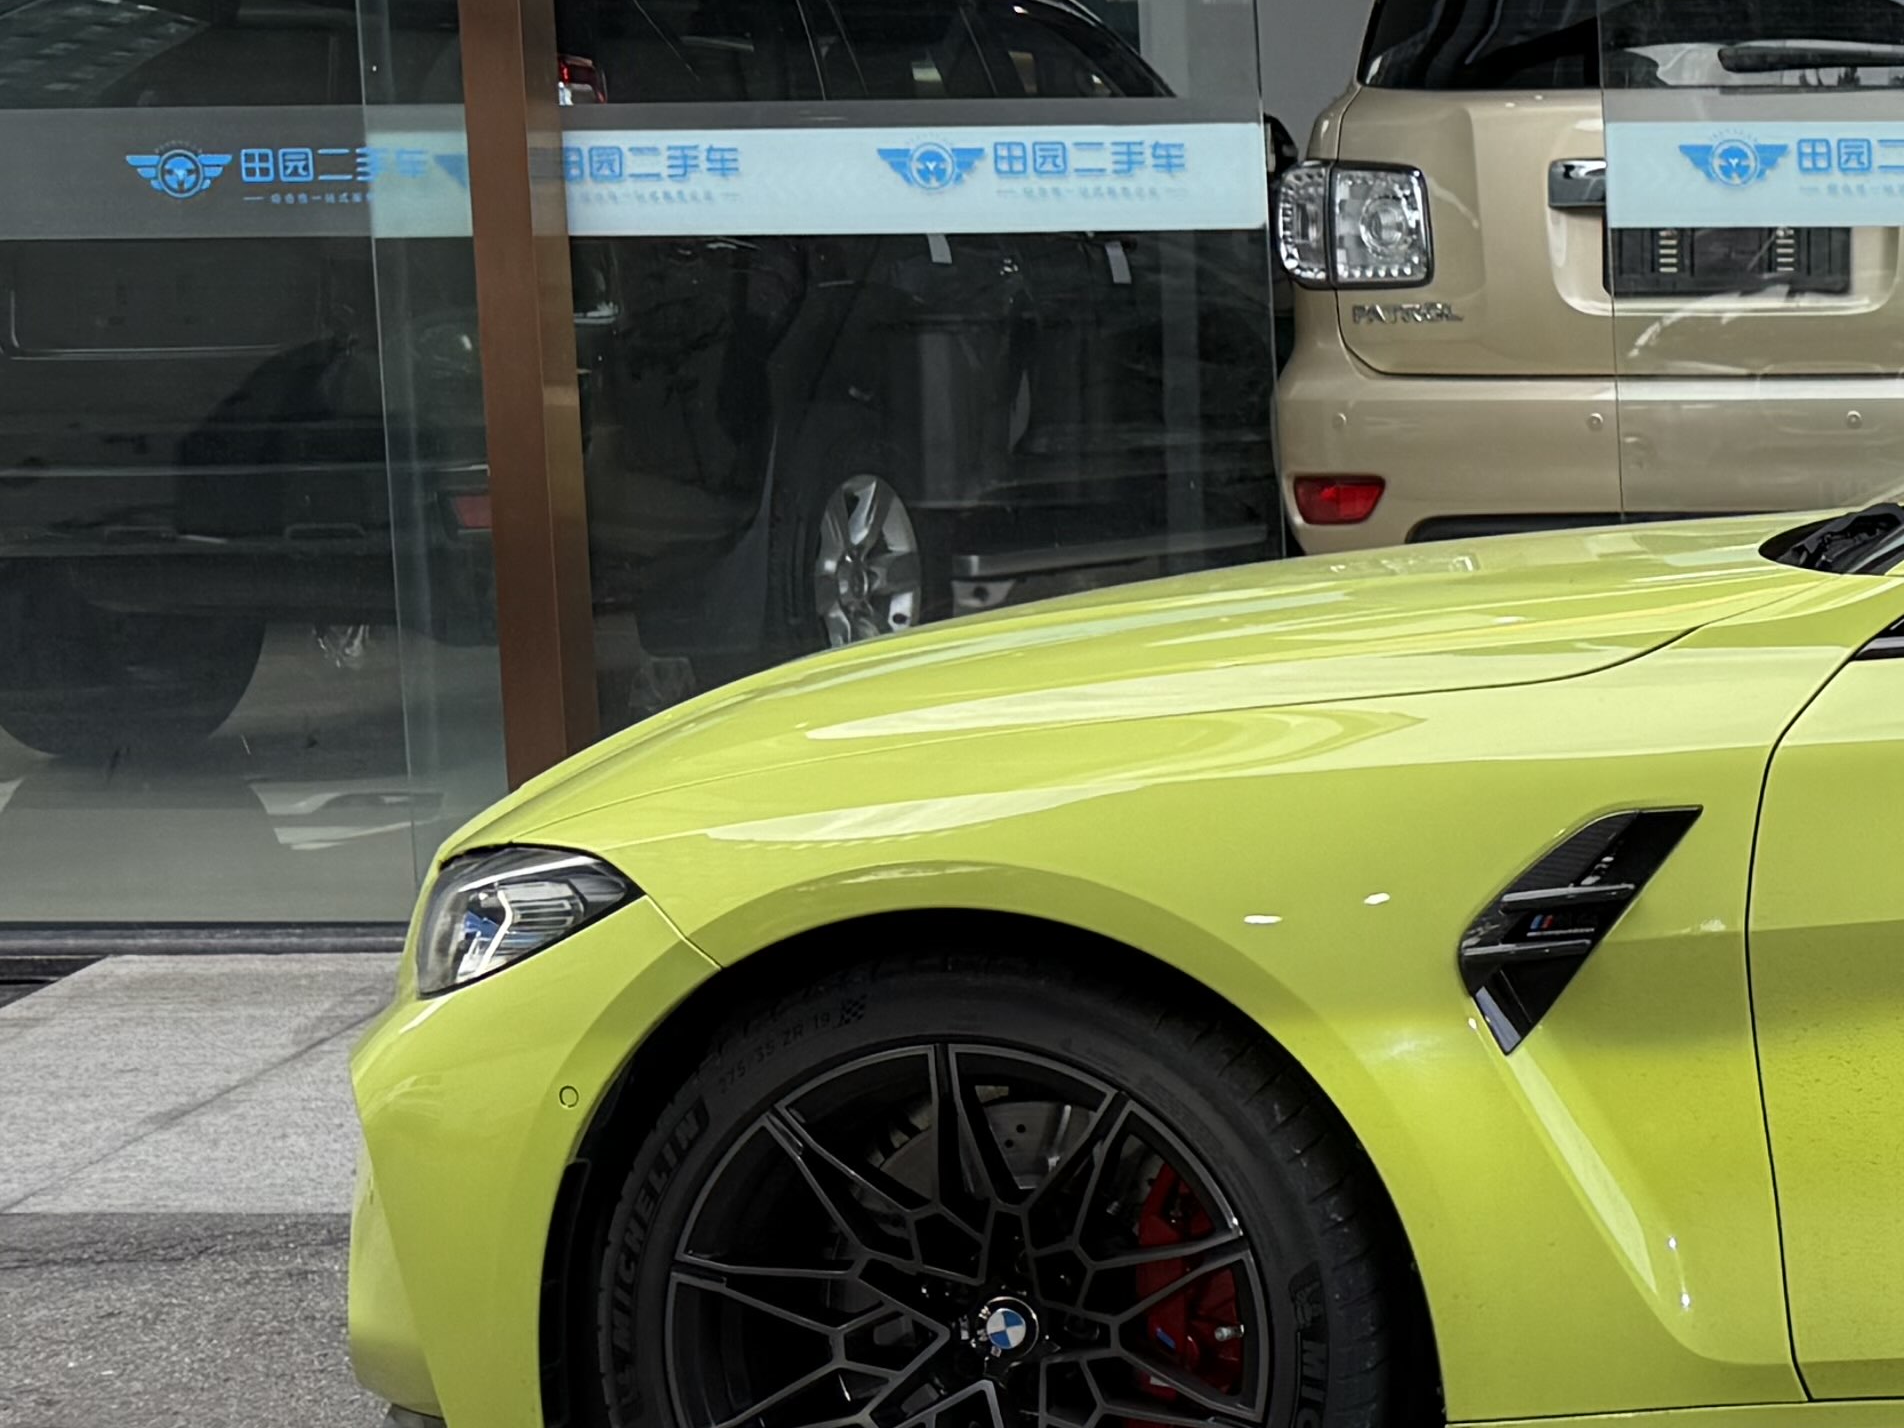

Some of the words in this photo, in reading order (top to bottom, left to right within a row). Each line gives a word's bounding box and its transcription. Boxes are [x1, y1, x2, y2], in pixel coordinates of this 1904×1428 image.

[993, 141, 1186, 176] 田园二手车
[610, 1107, 702, 1355] MICHELIN
